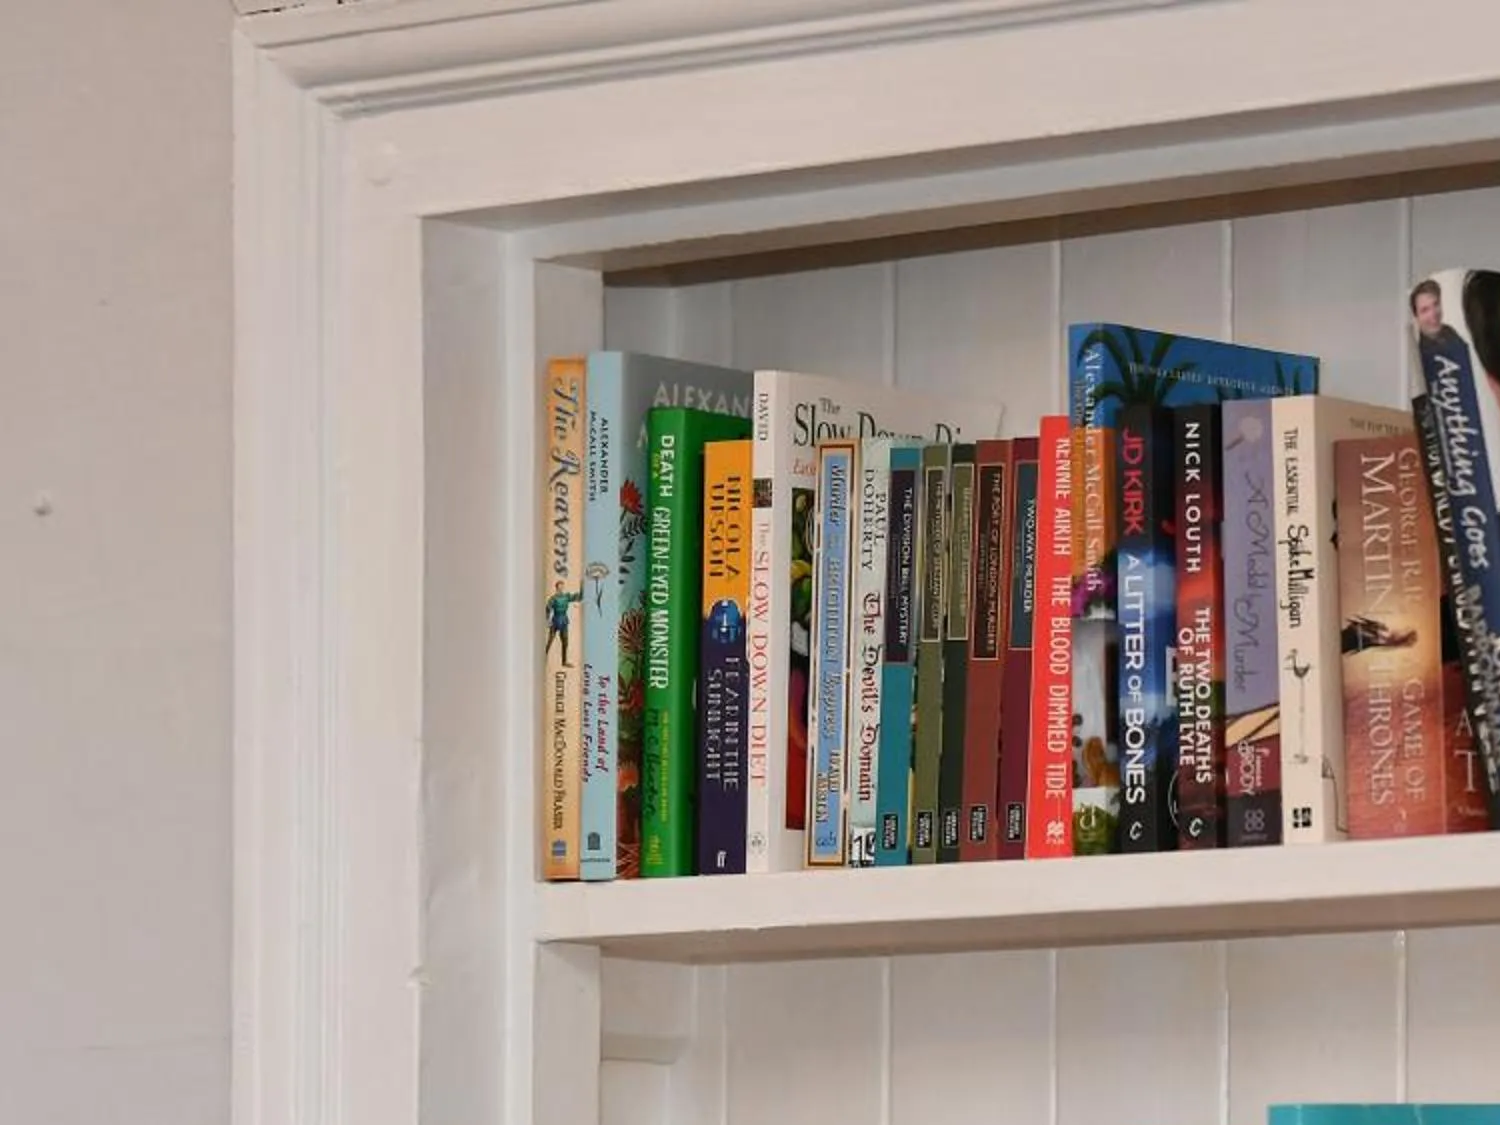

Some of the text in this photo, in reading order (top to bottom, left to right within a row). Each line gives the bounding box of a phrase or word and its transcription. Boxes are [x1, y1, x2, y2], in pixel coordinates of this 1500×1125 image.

[549, 377, 582, 582] The Reavers
[599, 417, 610, 494] ALEXANDER
[659, 434, 676, 497] DEATH
[757, 392, 769, 442] DAVID
[792, 402, 851, 448] Slow
[1122, 426, 1145, 537] JD KIRK
[1431, 355, 1482, 498] Anything
[1460, 505, 1490, 569] Goes
[862, 468, 877, 571] DOHERTY
[875, 493, 889, 546] PAUL
[1184, 422, 1203, 573] NICK LOUTH
[1278, 427, 1312, 566] THE Spike
[1359, 452, 1397, 617] MARTIN
[1399, 447, 1420, 551] GEORGE
[648, 506, 672, 689] GREEN-EYED MONSTER
[1044, 438, 1072, 800] RENNIE AIRTH THE BLOOD DIMMED TIDE
[595, 673, 611, 772] To the Land of
[750, 550, 770, 788] SLOW DOWN DIET
[857, 643, 887, 803] Devil's Domain
[1124, 554, 1146, 804] A LITTER OF BONES
[1179, 627, 1196, 766] OF RUTH LYLE
[1194, 607, 1213, 784] THE TWO DEATHS
[1367, 663, 1398, 806] THRONES
[580, 733, 594, 784] Friends
[722, 751, 740, 794] THE
[1402, 678, 1427, 803] GAME OF
